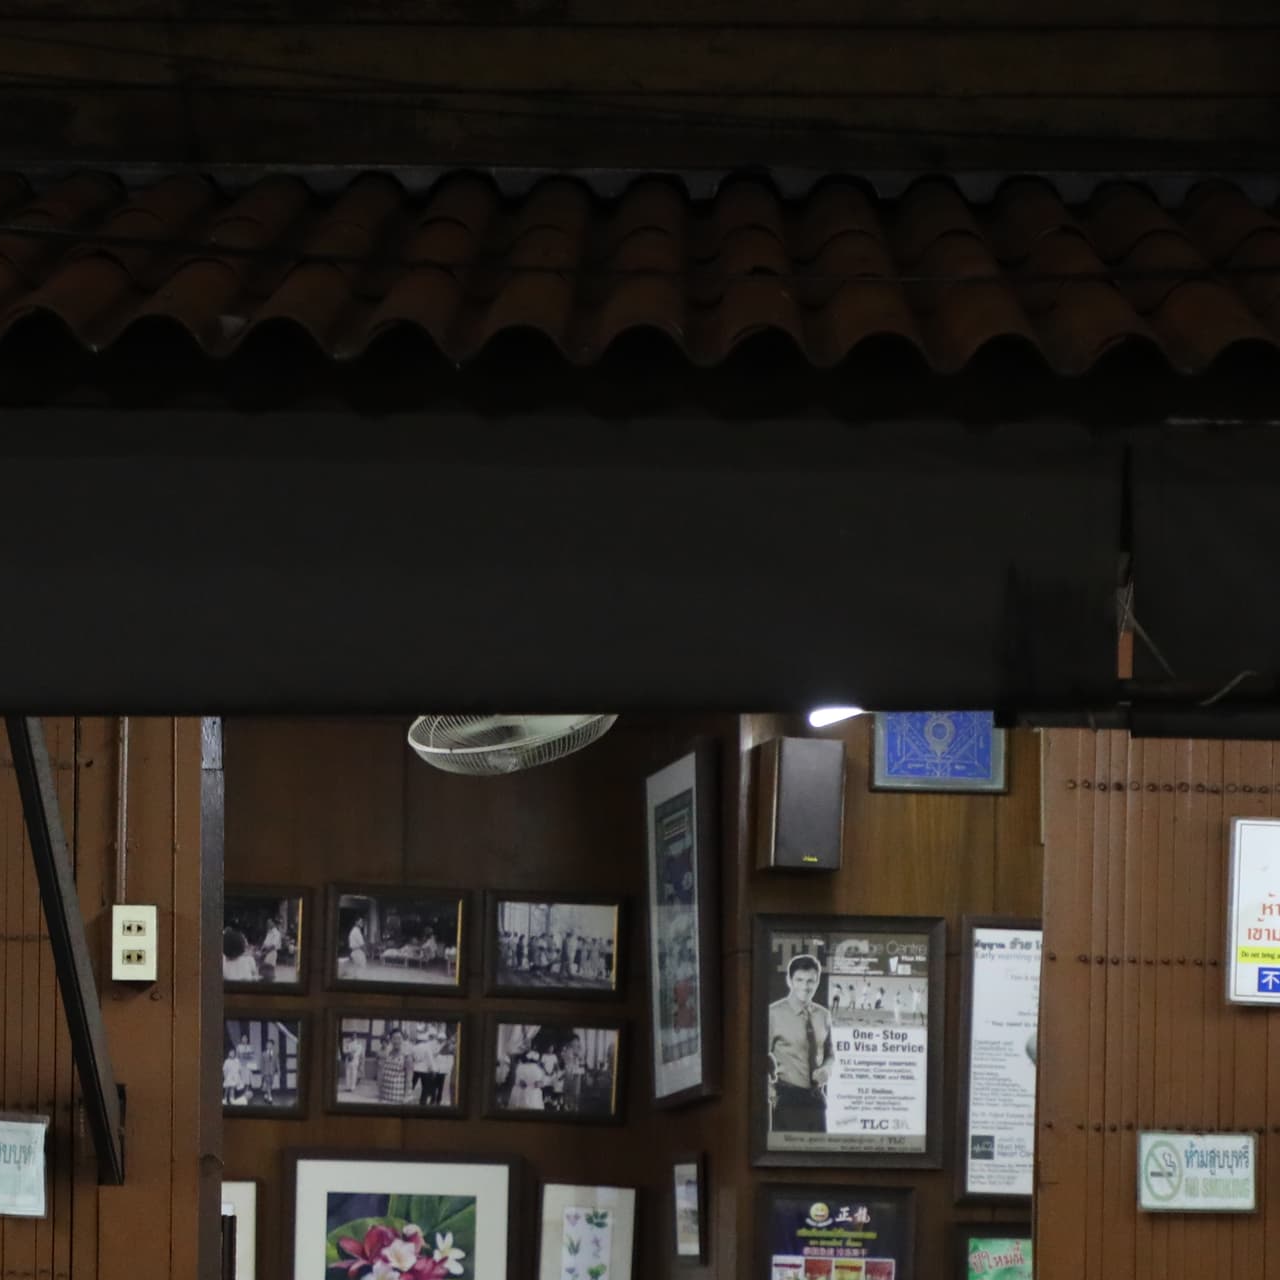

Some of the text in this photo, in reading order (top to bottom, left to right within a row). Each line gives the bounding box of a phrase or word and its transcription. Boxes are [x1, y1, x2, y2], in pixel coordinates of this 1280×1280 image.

[852, 1028, 873, 1041] One
[882, 1029, 908, 1043] Stop
[836, 1041, 924, 1053] ED Visa Service
[860, 1119, 889, 1130] TLC
